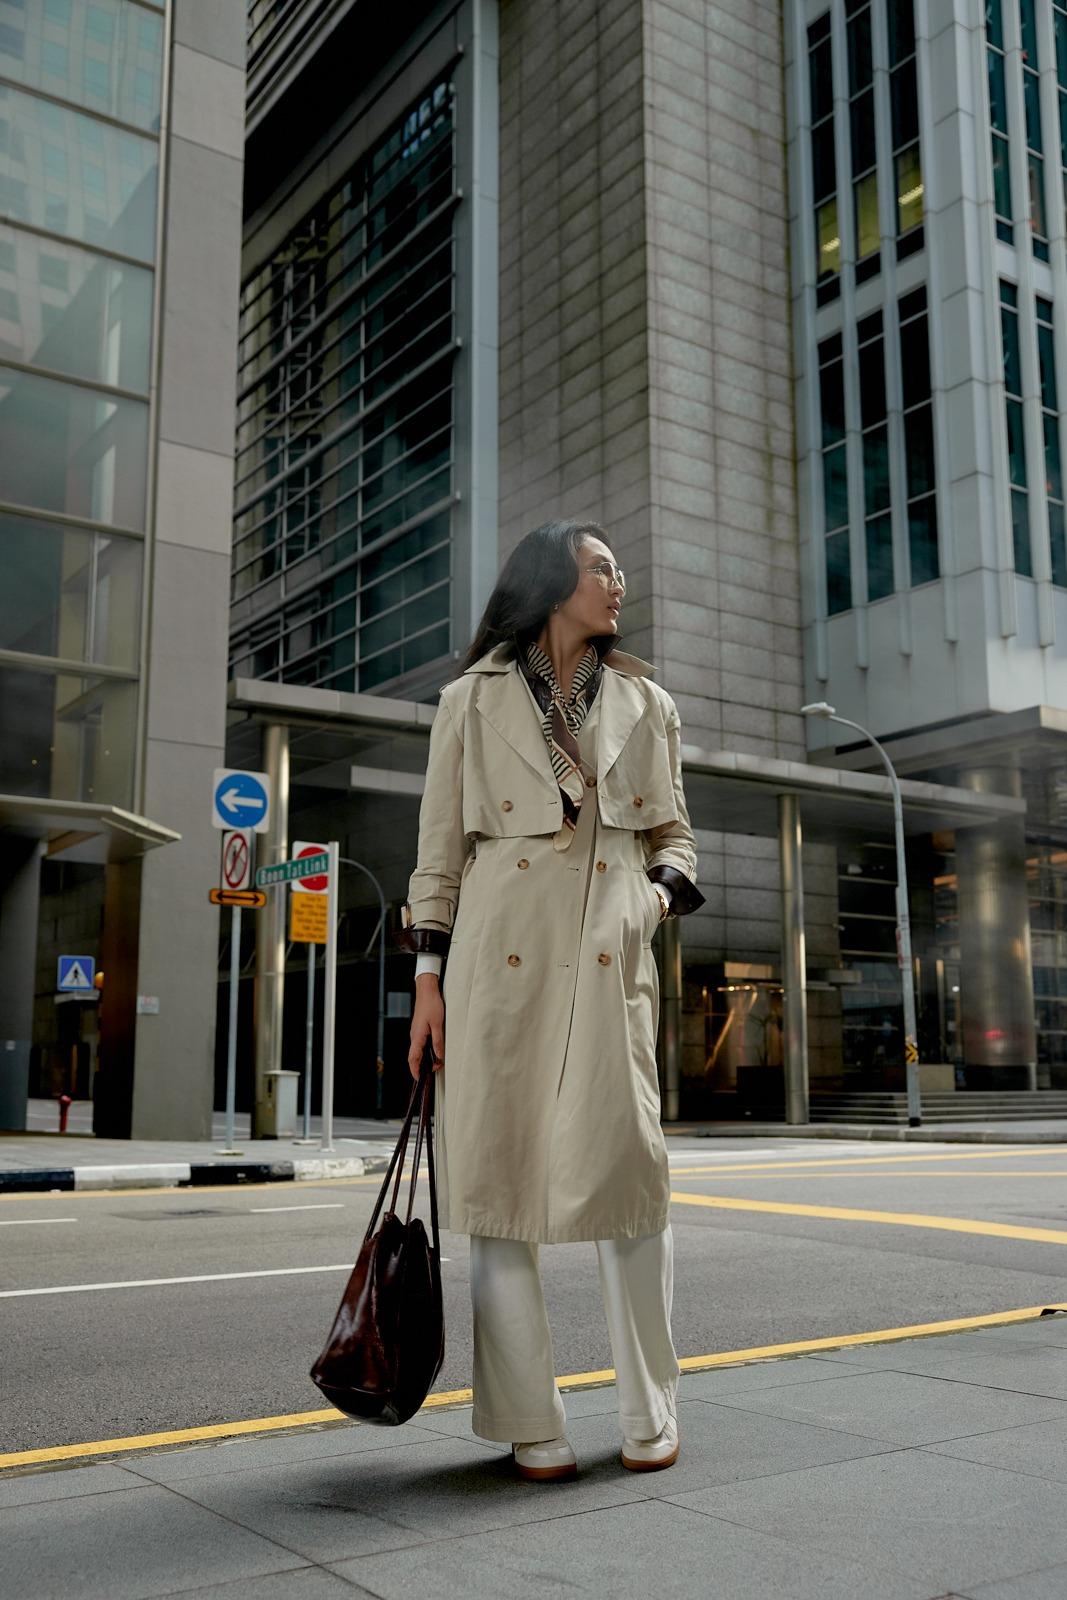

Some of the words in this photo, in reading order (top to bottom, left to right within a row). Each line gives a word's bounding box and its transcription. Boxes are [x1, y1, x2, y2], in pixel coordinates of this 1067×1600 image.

[260, 869, 284, 885] Boon
[287, 863, 303, 878] Tat
[305, 856, 326, 874] Link
